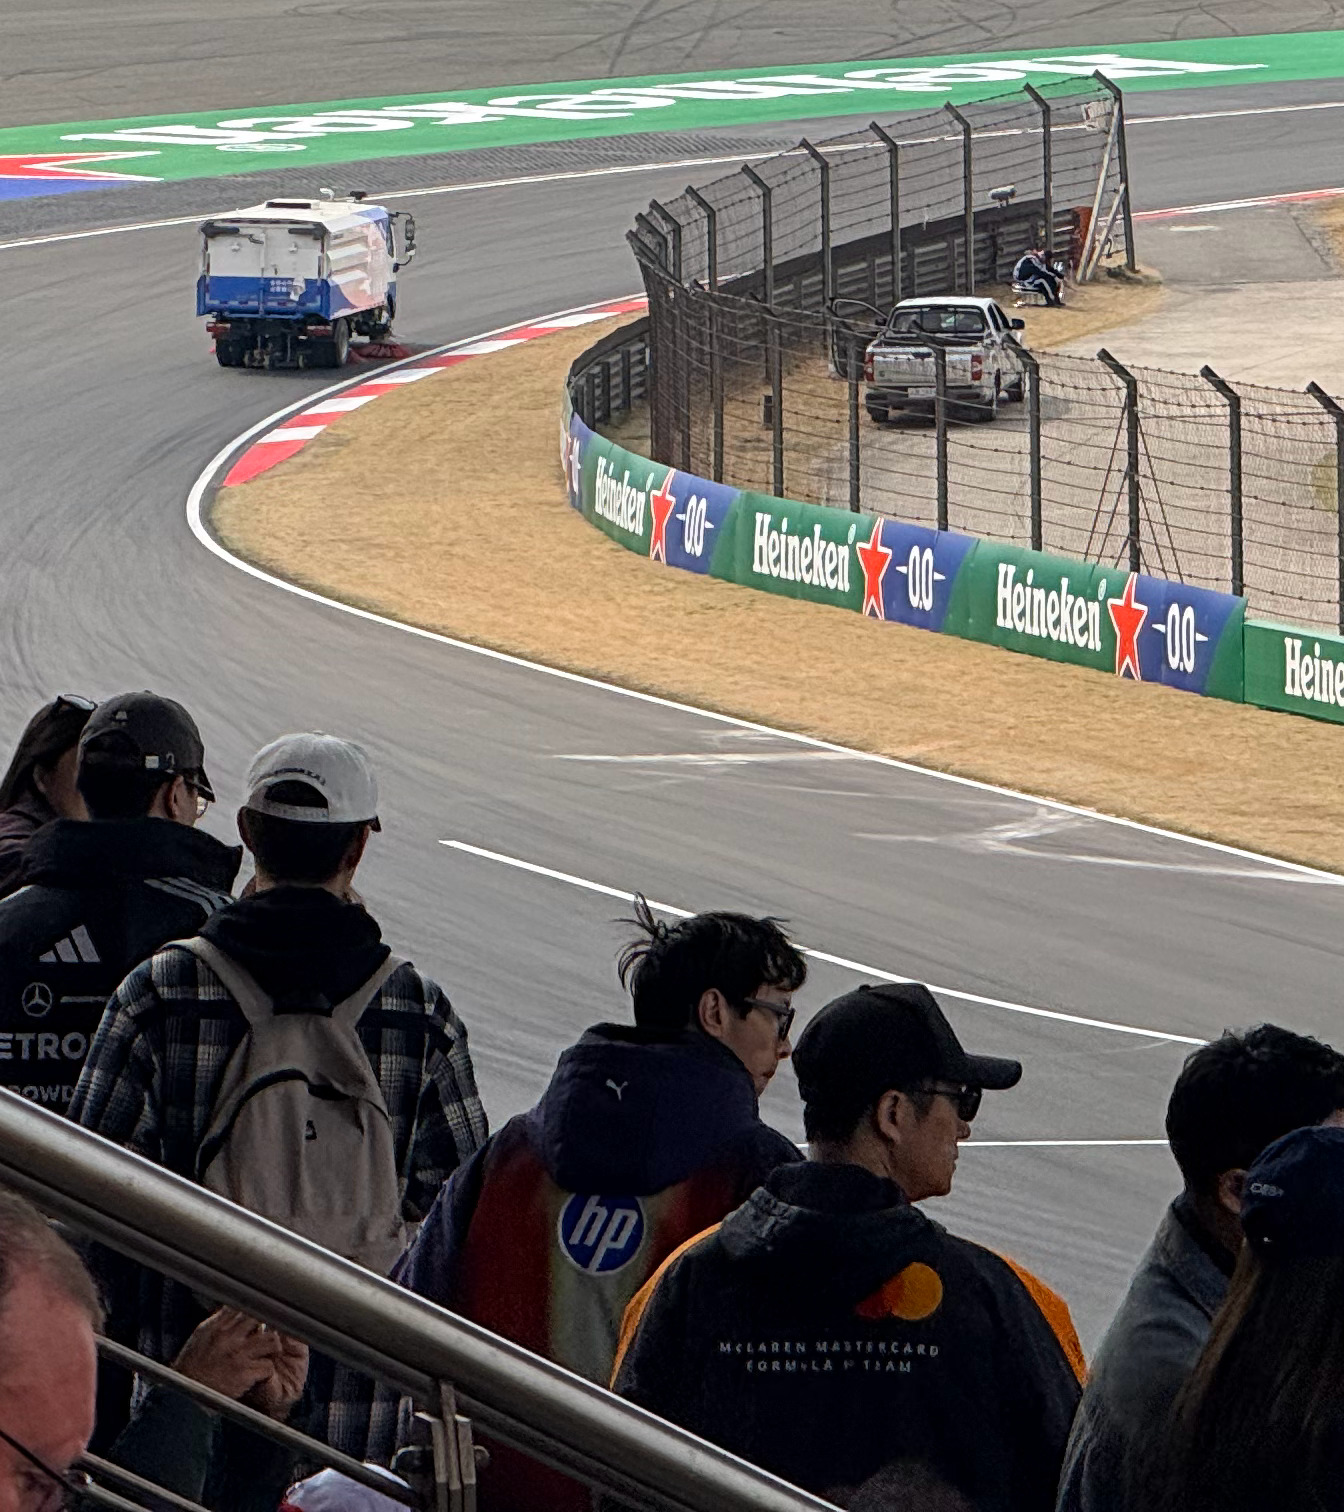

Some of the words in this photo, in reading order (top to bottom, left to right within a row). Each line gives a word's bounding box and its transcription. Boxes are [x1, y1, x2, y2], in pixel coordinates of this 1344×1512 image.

[595, 456, 645, 536] Heineken
[753, 512, 850, 593] Heineken
[997, 563, 1102, 652] Heineken
[569, 1195, 638, 1274] hp
[816, 1341, 939, 1357] MASTERCARD
